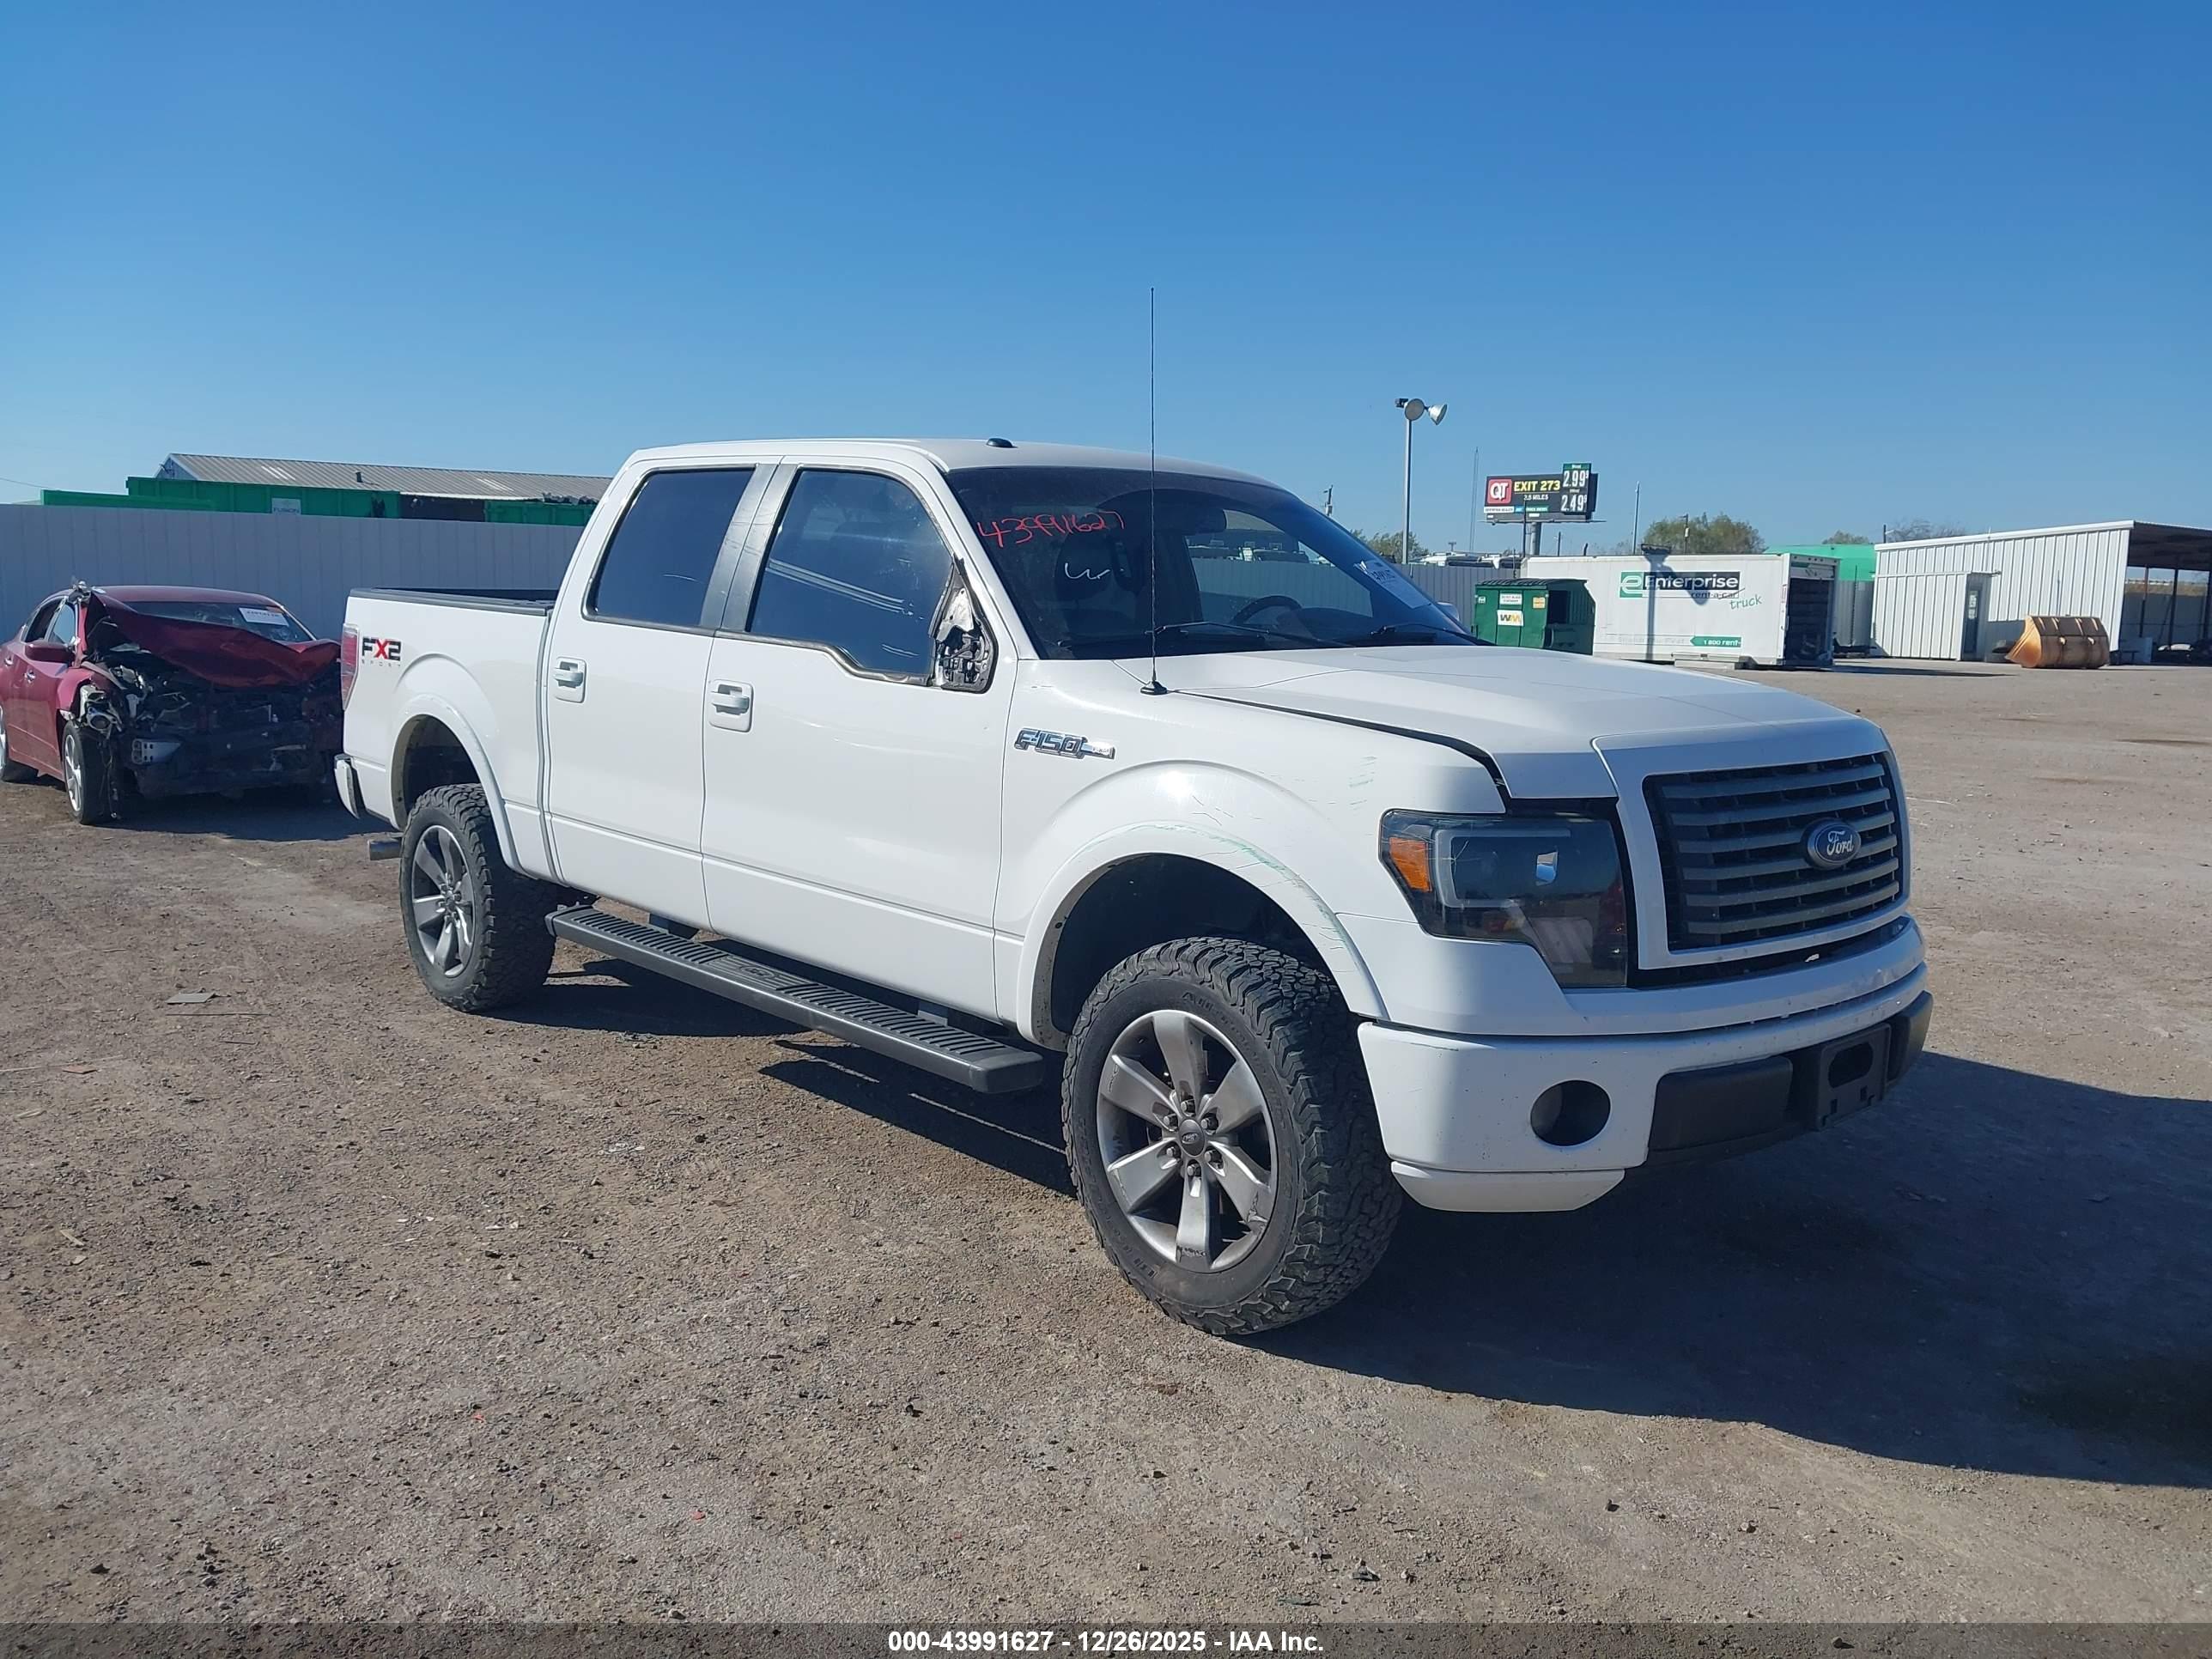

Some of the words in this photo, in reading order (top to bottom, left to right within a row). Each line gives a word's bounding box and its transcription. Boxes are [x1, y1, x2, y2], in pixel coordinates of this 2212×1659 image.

[1490, 482, 1509, 500] QT
[1513, 481, 1538, 492] EXIT
[1540, 480, 1560, 491] 273
[977, 511, 1125, 548] 43991627
[1644, 574, 1739, 590] Enterprise
[1729, 593, 1763, 611] truck
[1499, 613, 1522, 625] WM
[362, 636, 402, 661] FX2
[1014, 727, 1088, 759] F-150
[1826, 830, 1854, 856] Ford
